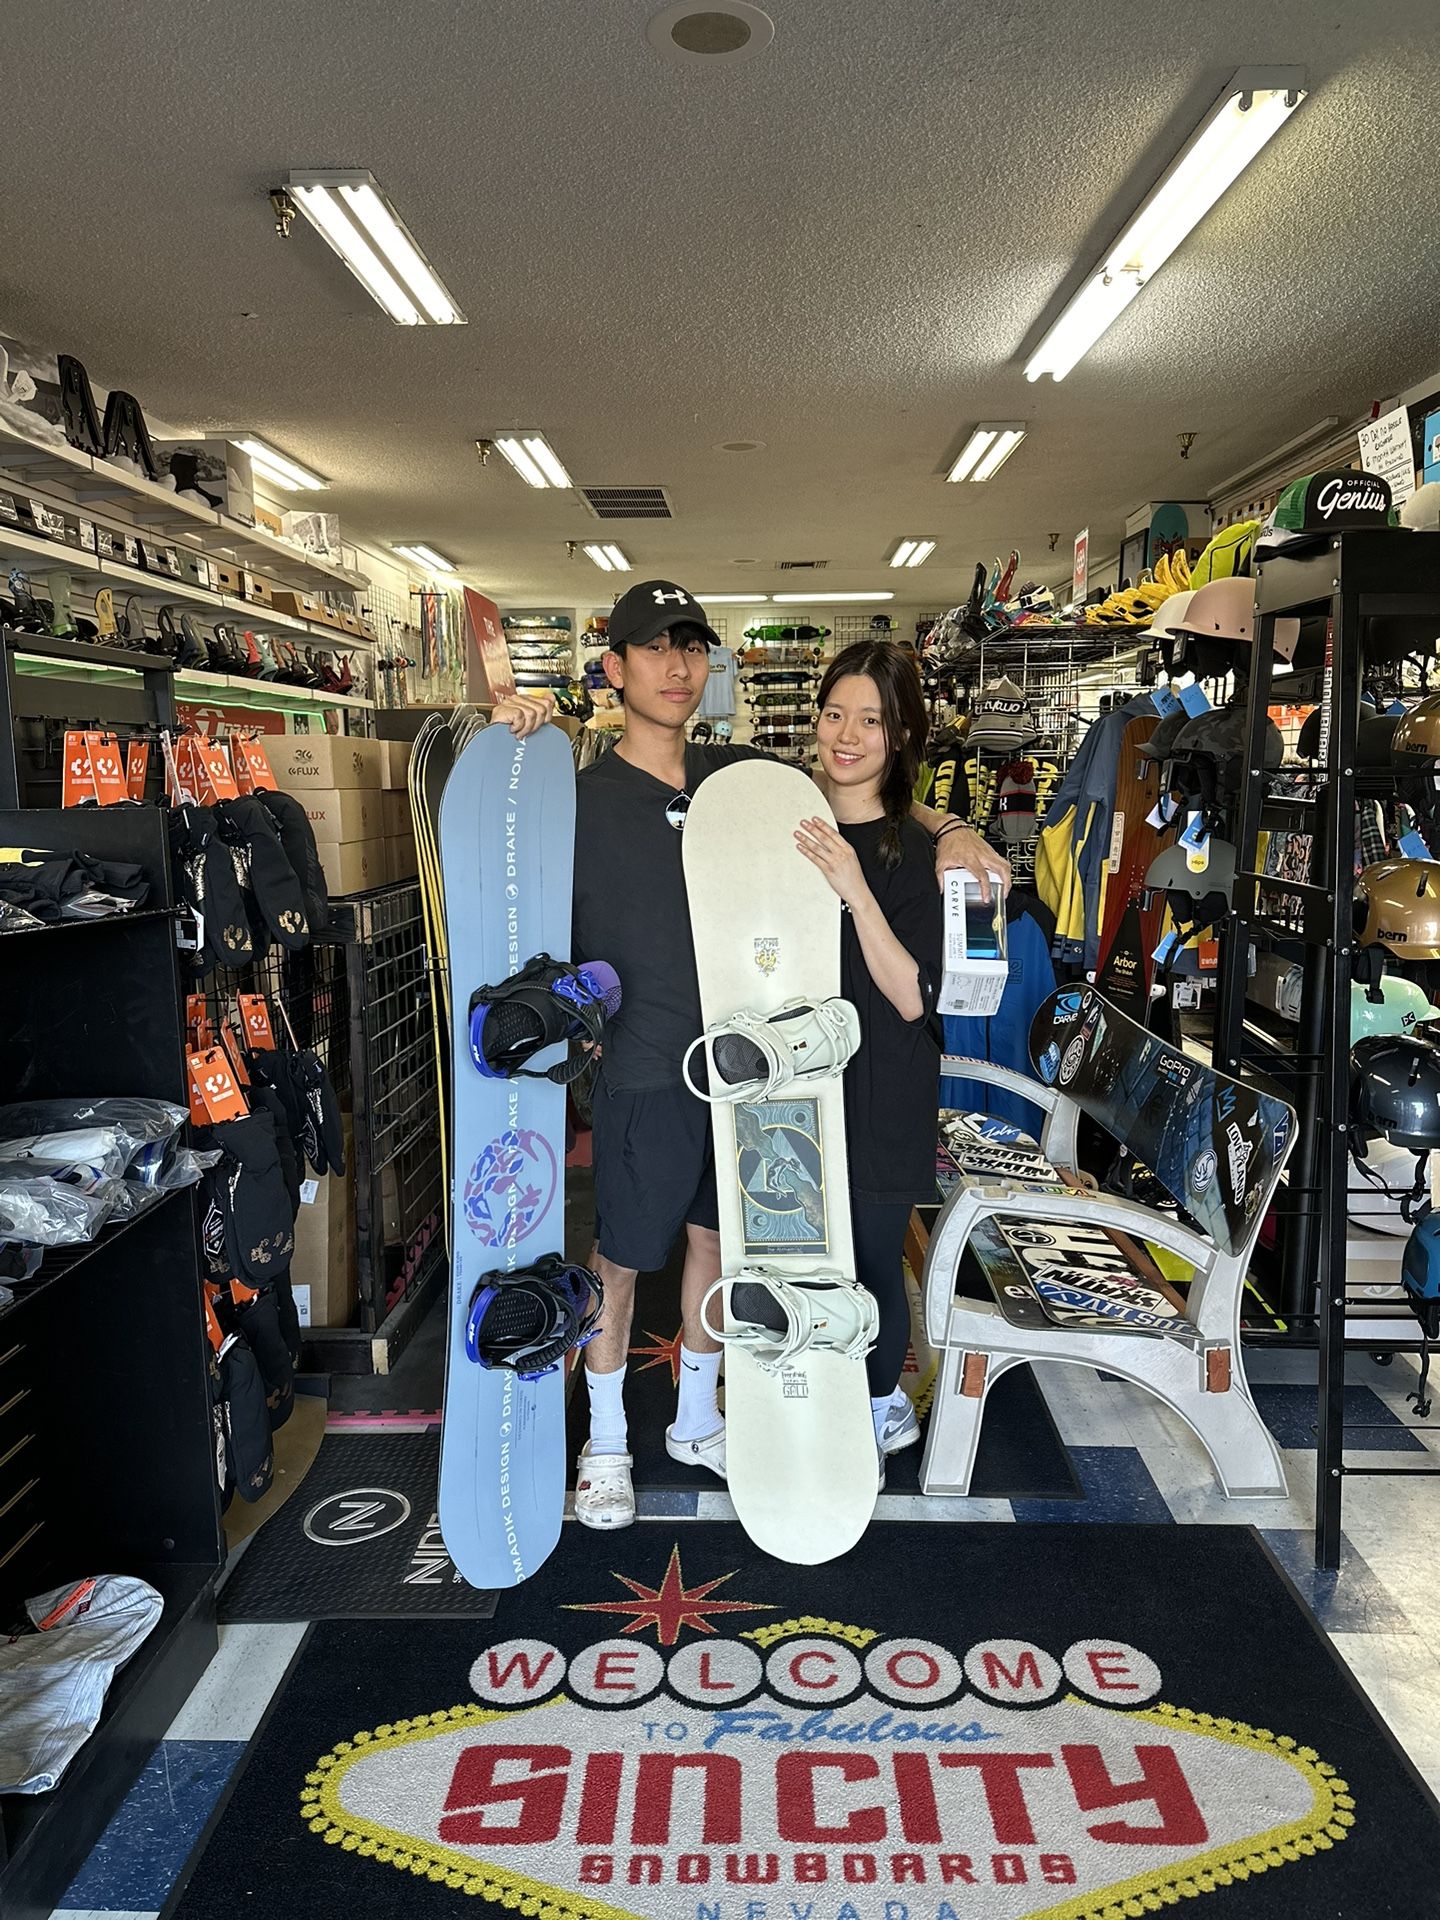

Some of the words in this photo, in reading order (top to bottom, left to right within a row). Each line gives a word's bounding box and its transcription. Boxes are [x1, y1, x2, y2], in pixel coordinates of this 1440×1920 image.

[1361, 433, 1370, 448] 30
[1347, 479, 1381, 489] OFFICIAL
[1317, 478, 1387, 520] Genius
[1405, 741, 1428, 754] bern
[296, 767, 320, 776] FLUX
[307, 811, 326, 820] LUX
[505, 811, 517, 877] DRAKE
[950, 880, 960, 918] CARVE
[1376, 928, 1408, 943] bern
[1113, 955, 1138, 970] Arbor
[1159, 1054, 1192, 1078] GoPro
[501, 1441, 512, 1509] DESIGN
[487, 1649, 1140, 1690] WELCOME
[642, 1721, 689, 1741] TO
[703, 1708, 1001, 1749] Fabulous
[577, 1853, 1078, 1885] SNOWBOARDS
